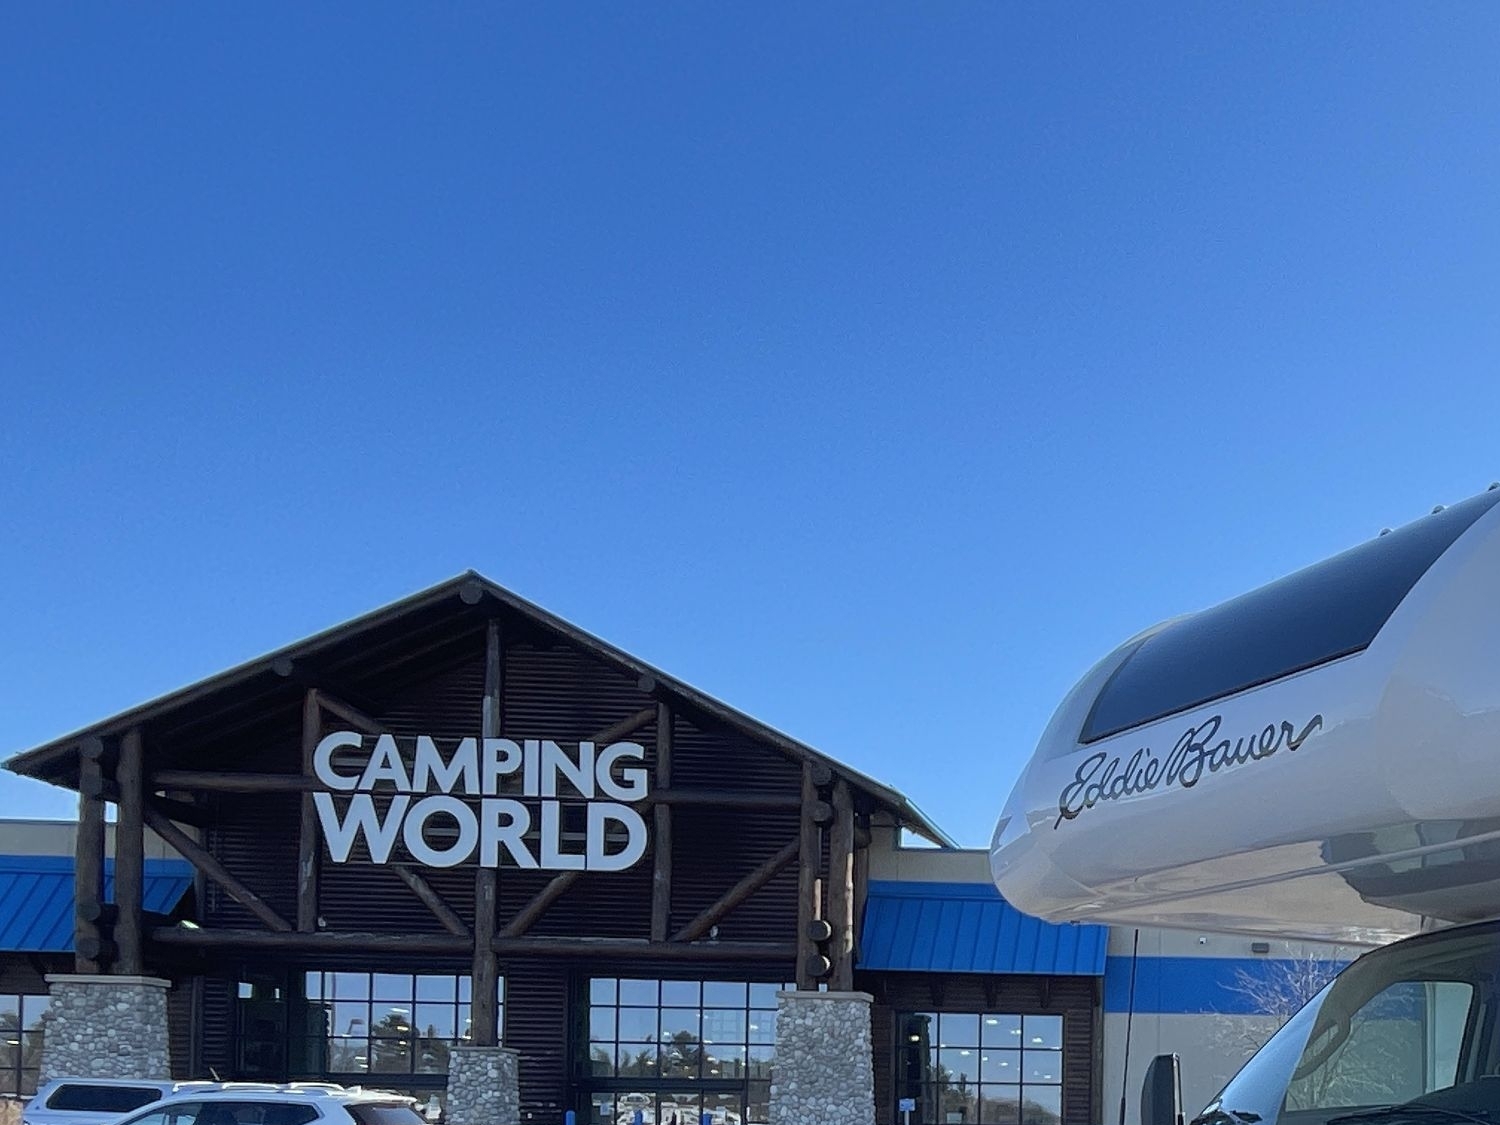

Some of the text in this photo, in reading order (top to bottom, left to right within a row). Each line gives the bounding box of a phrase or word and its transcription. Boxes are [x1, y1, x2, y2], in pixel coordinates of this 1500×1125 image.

[312, 730, 649, 802] CAMPING
[1053, 714, 1323, 830] Eddie Bauer
[312, 791, 649, 872] WORLD
